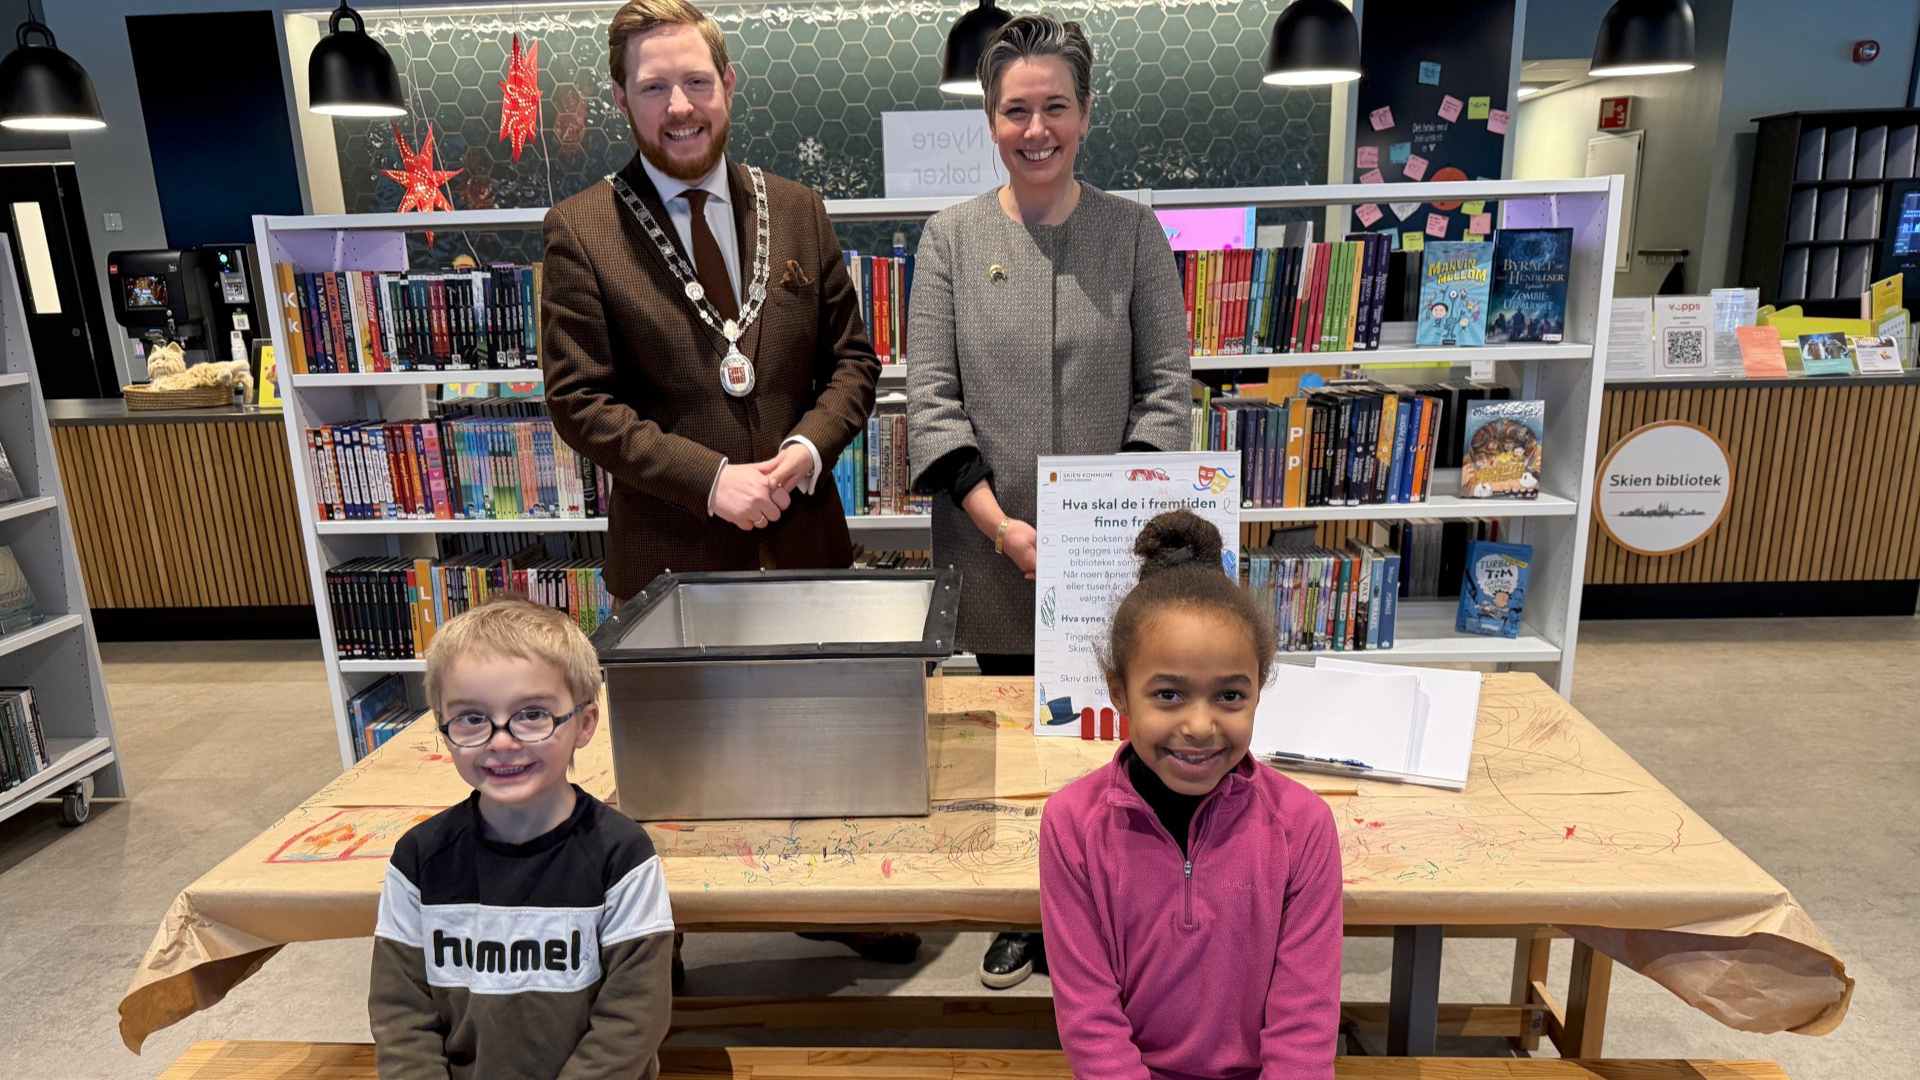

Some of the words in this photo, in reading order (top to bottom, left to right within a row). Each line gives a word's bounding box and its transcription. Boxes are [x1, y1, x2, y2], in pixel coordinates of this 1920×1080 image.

[283, 292, 297, 308] K
[1289, 427, 1303, 443] P
[1609, 474, 1652, 487] Skien
[1656, 474, 1721, 487] bibliotek
[1062, 499, 1088, 510] Hva
[1091, 498, 1117, 510] skal
[1121, 498, 1137, 510] de
[1141, 498, 1145, 509] i
[1149, 497, 1216, 510] fremtiden
[1094, 516, 1129, 528] finne
[1061, 534, 1090, 543] Denne
[1092, 533, 1123, 543] boksen
[1068, 547, 1080, 557] og
[1082, 546, 1111, 557] legges
[1070, 559, 1115, 567] biblioteket
[1063, 570, 1078, 578] Når
[420, 586, 431, 600] L
[1061, 615, 1079, 623] Hva
[1081, 616, 1105, 625] synes
[1060, 674, 1081, 682] Skriv
